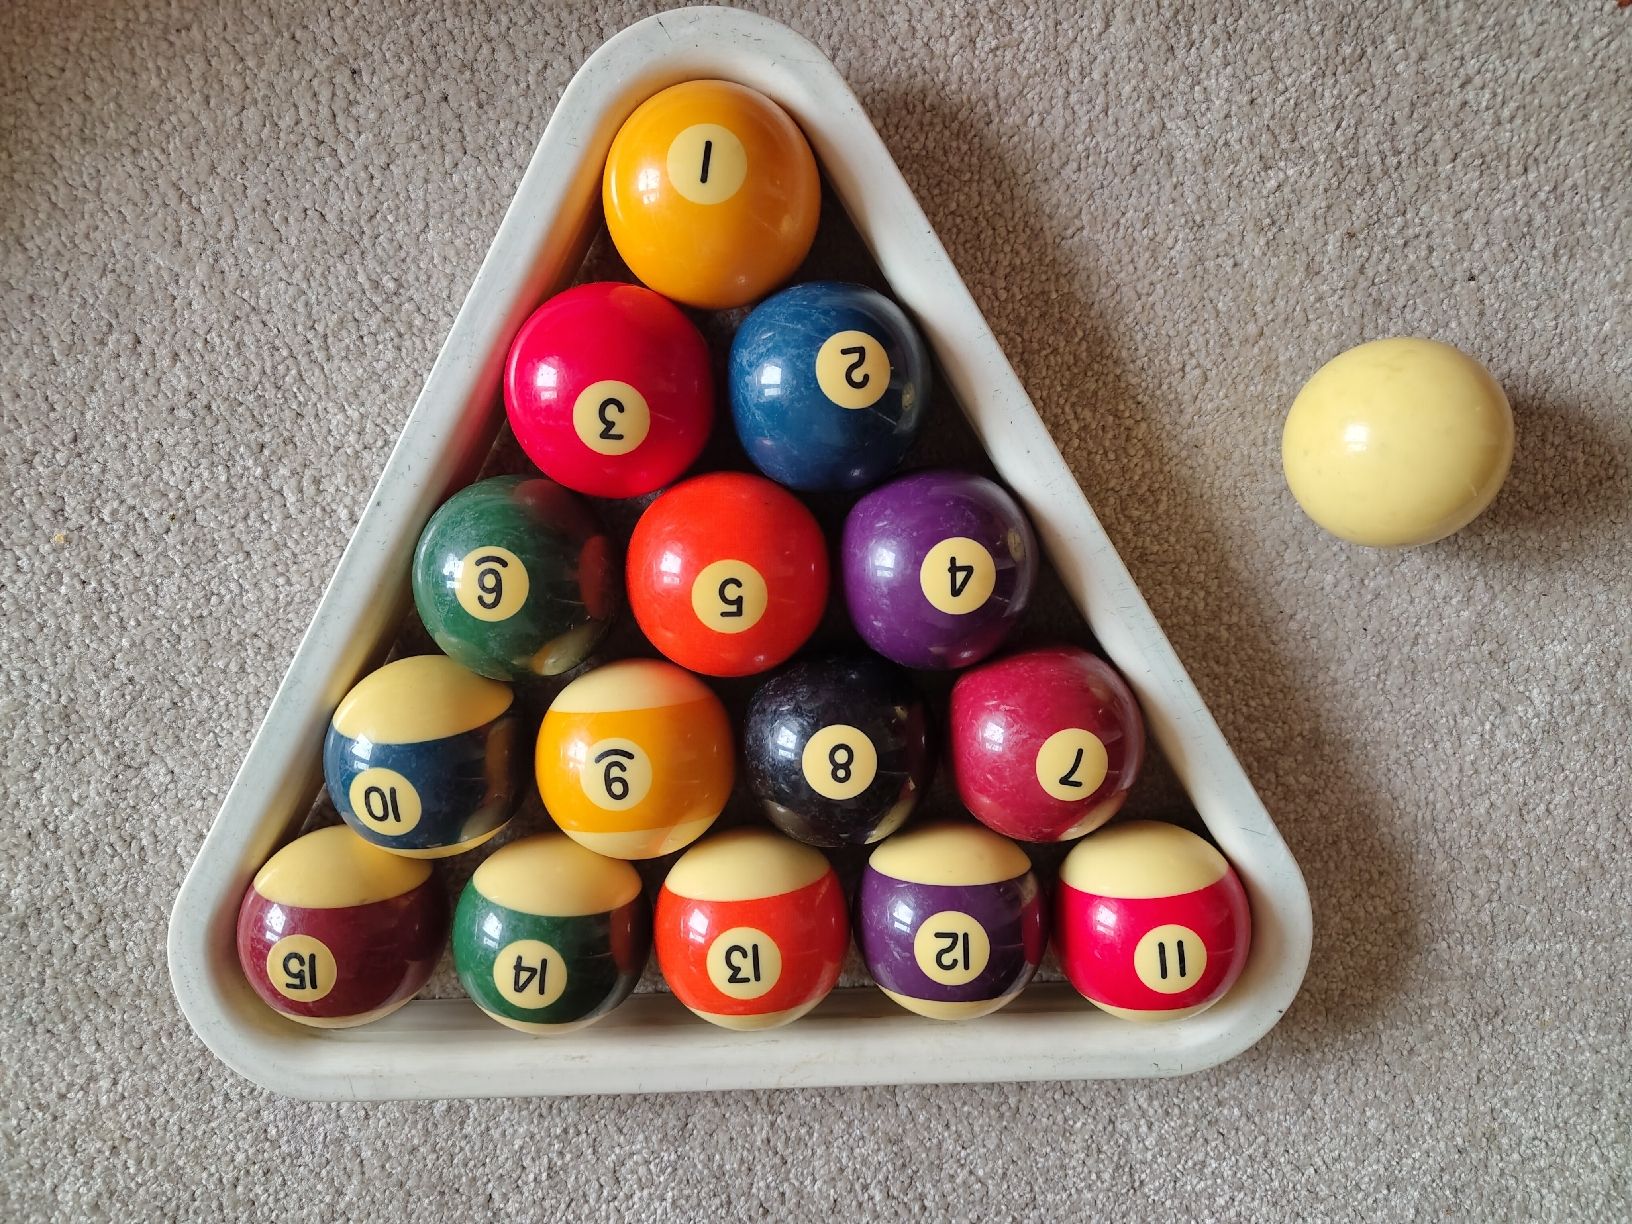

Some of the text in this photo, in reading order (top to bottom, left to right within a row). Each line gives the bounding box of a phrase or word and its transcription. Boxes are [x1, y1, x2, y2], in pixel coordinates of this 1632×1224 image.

[700, 140, 713, 184] 1
[840, 346, 871, 390] 2
[598, 397, 626, 441] 3
[476, 565, 504, 610] 6
[718, 577, 744, 618] 5
[947, 556, 975, 598] 4
[602, 758, 632, 801] 9
[828, 743, 855, 784] 8
[1058, 747, 1084, 788] 7
[364, 785, 402, 823] 10
[282, 951, 319, 991] 15
[724, 943, 762, 984] 13
[933, 931, 970, 971] 12
[1157, 939, 1187, 980] 11
[513, 954, 548, 996] 14
